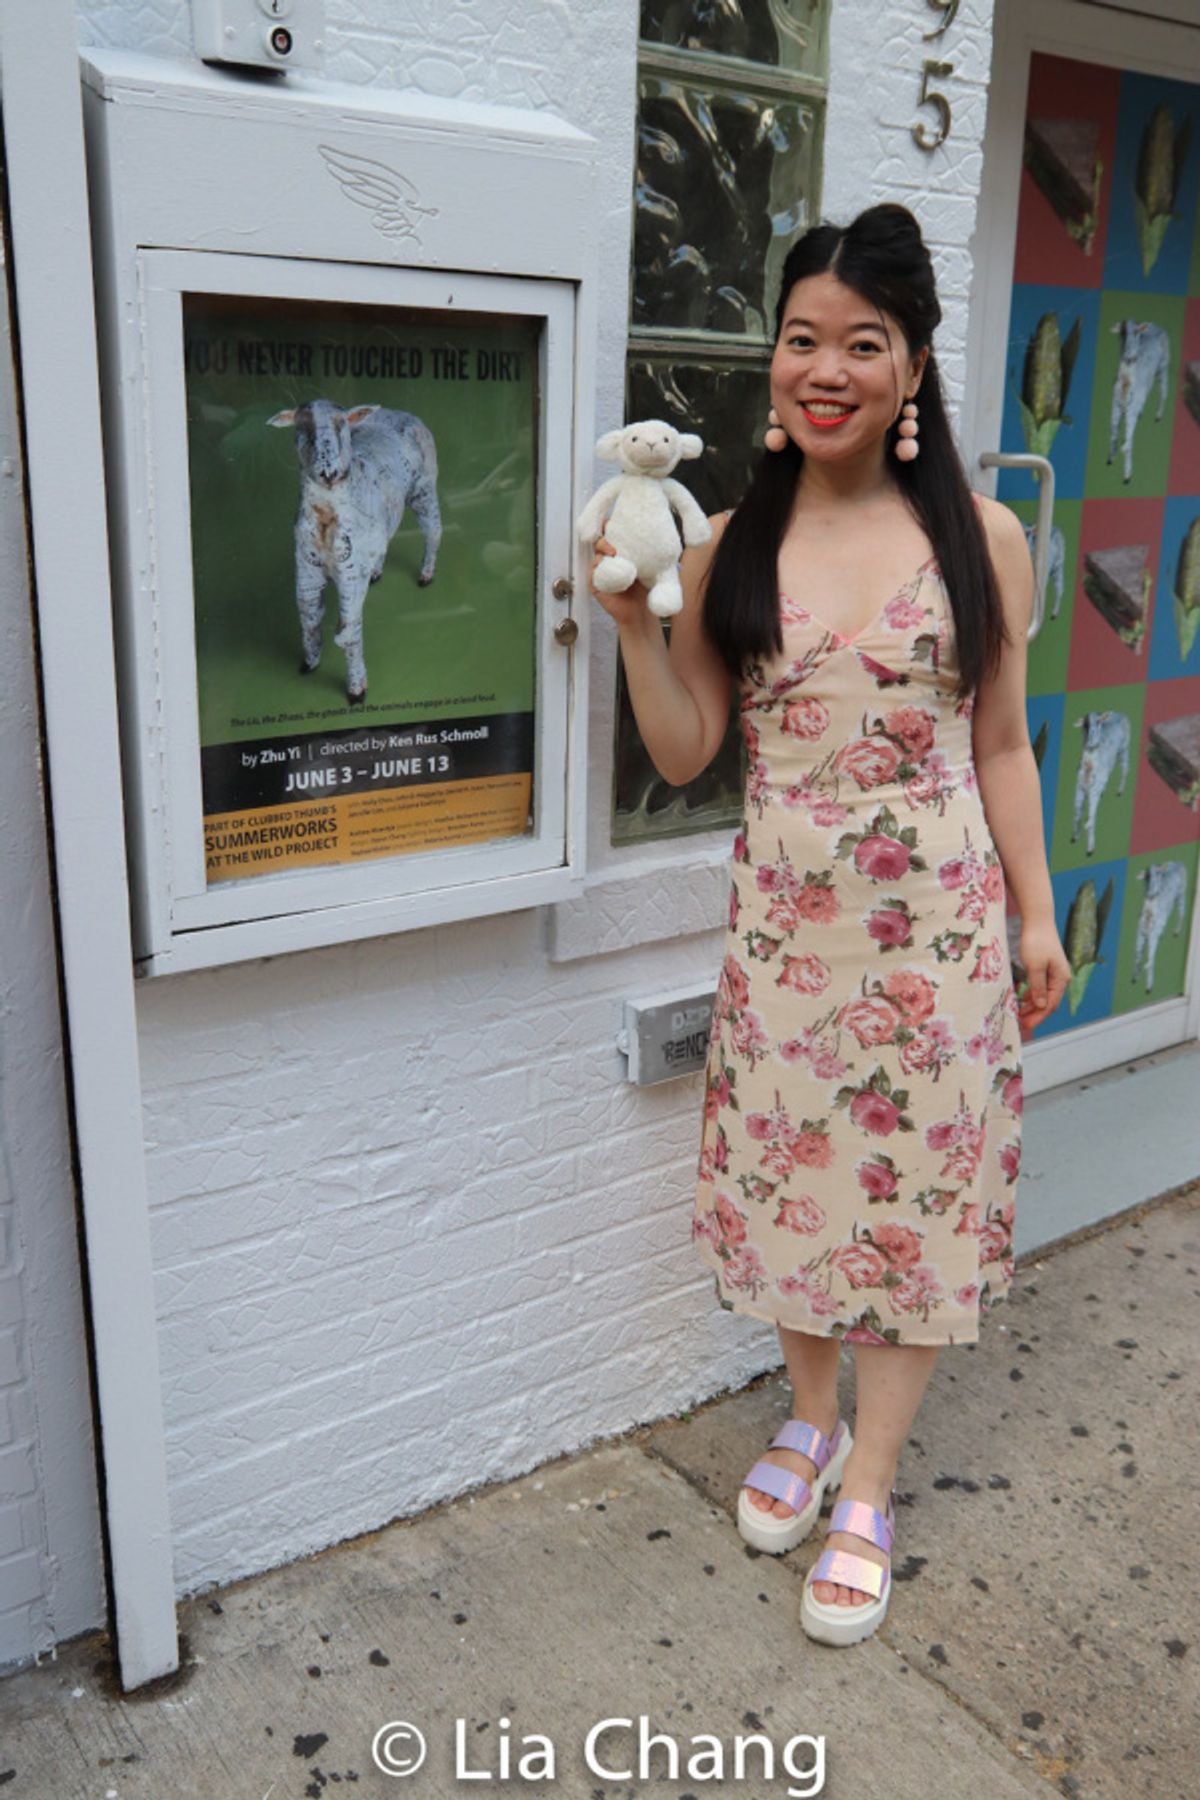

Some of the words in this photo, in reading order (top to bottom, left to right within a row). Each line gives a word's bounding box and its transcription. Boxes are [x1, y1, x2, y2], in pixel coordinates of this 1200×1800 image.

[237, 340, 313, 377] NEVER
[321, 343, 423, 379] TOUCHED
[430, 347, 469, 381] THE
[476, 349, 524, 382] DIRT
[241, 751, 258, 769] by
[260, 749, 286, 764] Zhu
[288, 746, 301, 760] Yi
[320, 738, 369, 755] directed
[372, 737, 388, 752] by
[389, 735, 413, 748] Ken
[416, 733, 438, 745] Rus
[440, 726, 489, 743] Schmoll
[285, 767, 337, 791] JUNE
[341, 766, 352, 783] 3
[371, 758, 422, 779] JUNE
[427, 755, 449, 773] 13
[204, 821, 229, 832] PART
[232, 819, 245, 829] OF
[248, 811, 293, 826] CLUBBED
[294, 804, 337, 818] THUMB'S
[205, 818, 338, 851] SUMMERWORKS
[206, 856, 222, 868] AT
[225, 852, 249, 865] THE
[250, 846, 283, 861] WILD
[286, 837, 338, 855] PROJECT
